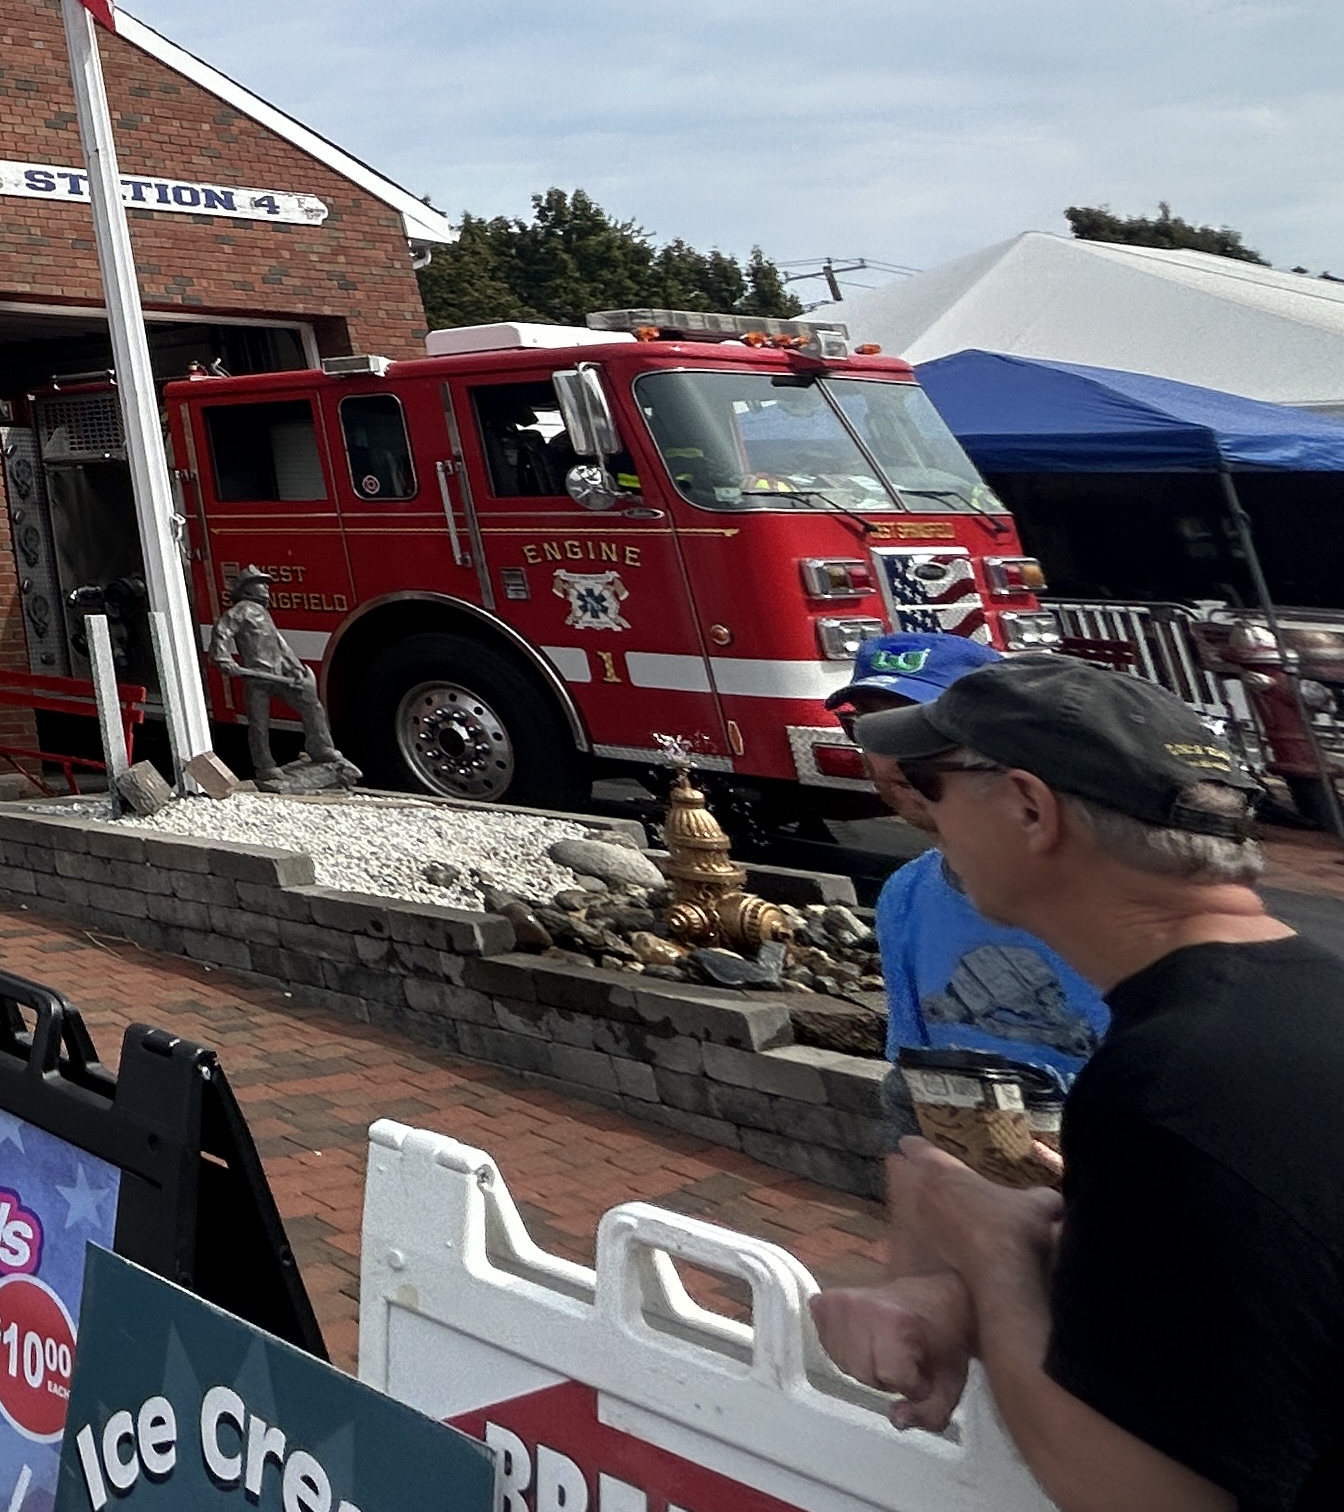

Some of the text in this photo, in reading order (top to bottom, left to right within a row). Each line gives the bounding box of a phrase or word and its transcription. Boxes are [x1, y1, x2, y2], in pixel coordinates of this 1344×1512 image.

[24, 169, 237, 211] STTION
[254, 195, 281, 215] 4
[522, 540, 641, 567] ENGINE
[260, 565, 306, 582] EST
[221, 591, 348, 611] SNGFIELD
[596, 651, 622, 683] 1
[76, 1396, 177, 1512] Ice
[201, 1386, 362, 1512] Cre
